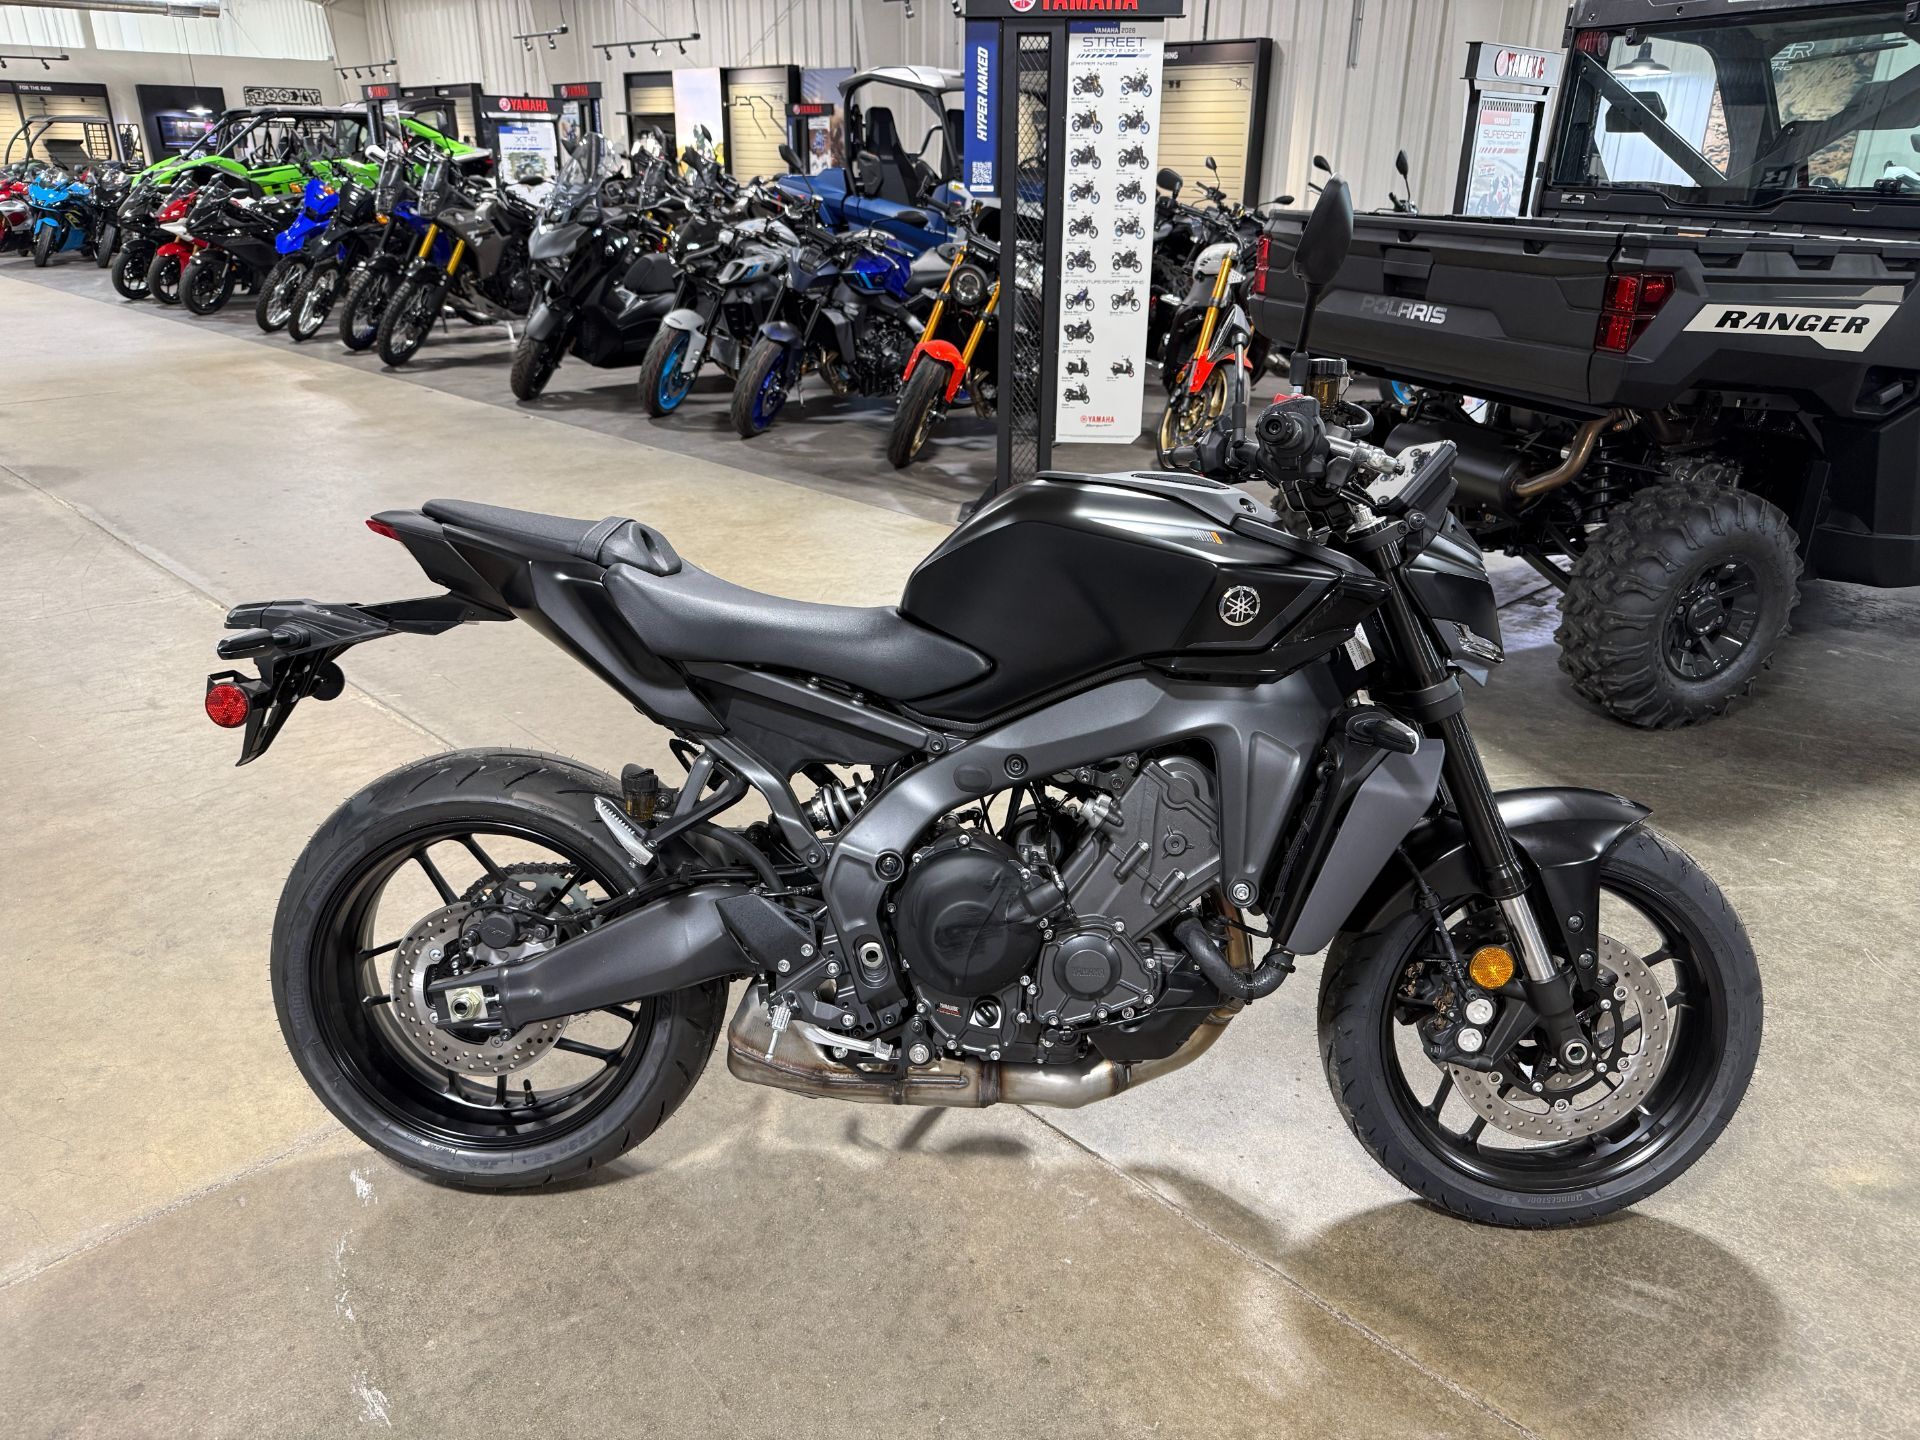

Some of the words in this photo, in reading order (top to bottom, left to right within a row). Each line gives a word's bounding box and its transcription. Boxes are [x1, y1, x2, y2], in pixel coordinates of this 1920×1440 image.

[1083, 36, 1147, 48] STREET
[977, 46, 989, 96] NAKED
[510, 99, 549, 112] YAMAHA
[977, 97, 989, 142] HYPER
[1361, 296, 1448, 324] POLARIS
[1714, 311, 1870, 334] RANGER
